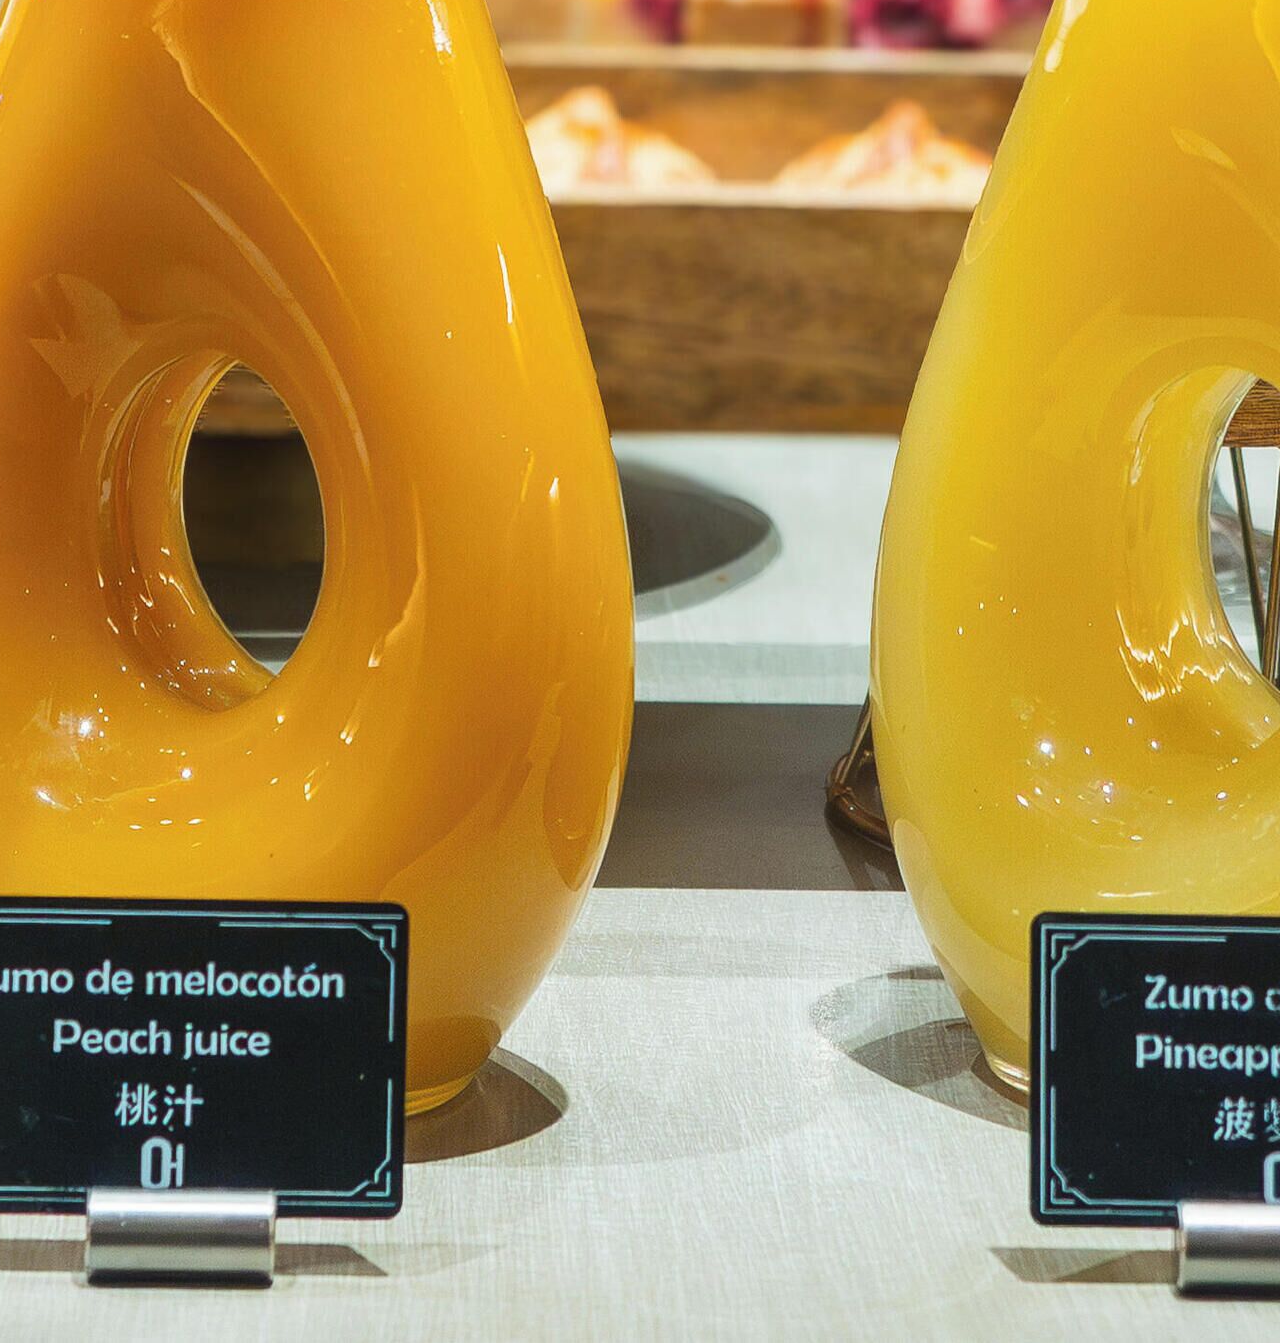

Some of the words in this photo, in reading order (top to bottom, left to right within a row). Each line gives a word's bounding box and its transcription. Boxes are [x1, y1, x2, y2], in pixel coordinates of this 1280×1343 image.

[85, 959, 134, 996] de
[145, 961, 345, 999] melocotón
[1144, 974, 1255, 1012] Zumo
[52, 1018, 172, 1056] Peach
[183, 1022, 271, 1061] juice
[114, 1081, 204, 1126] 桃汁
